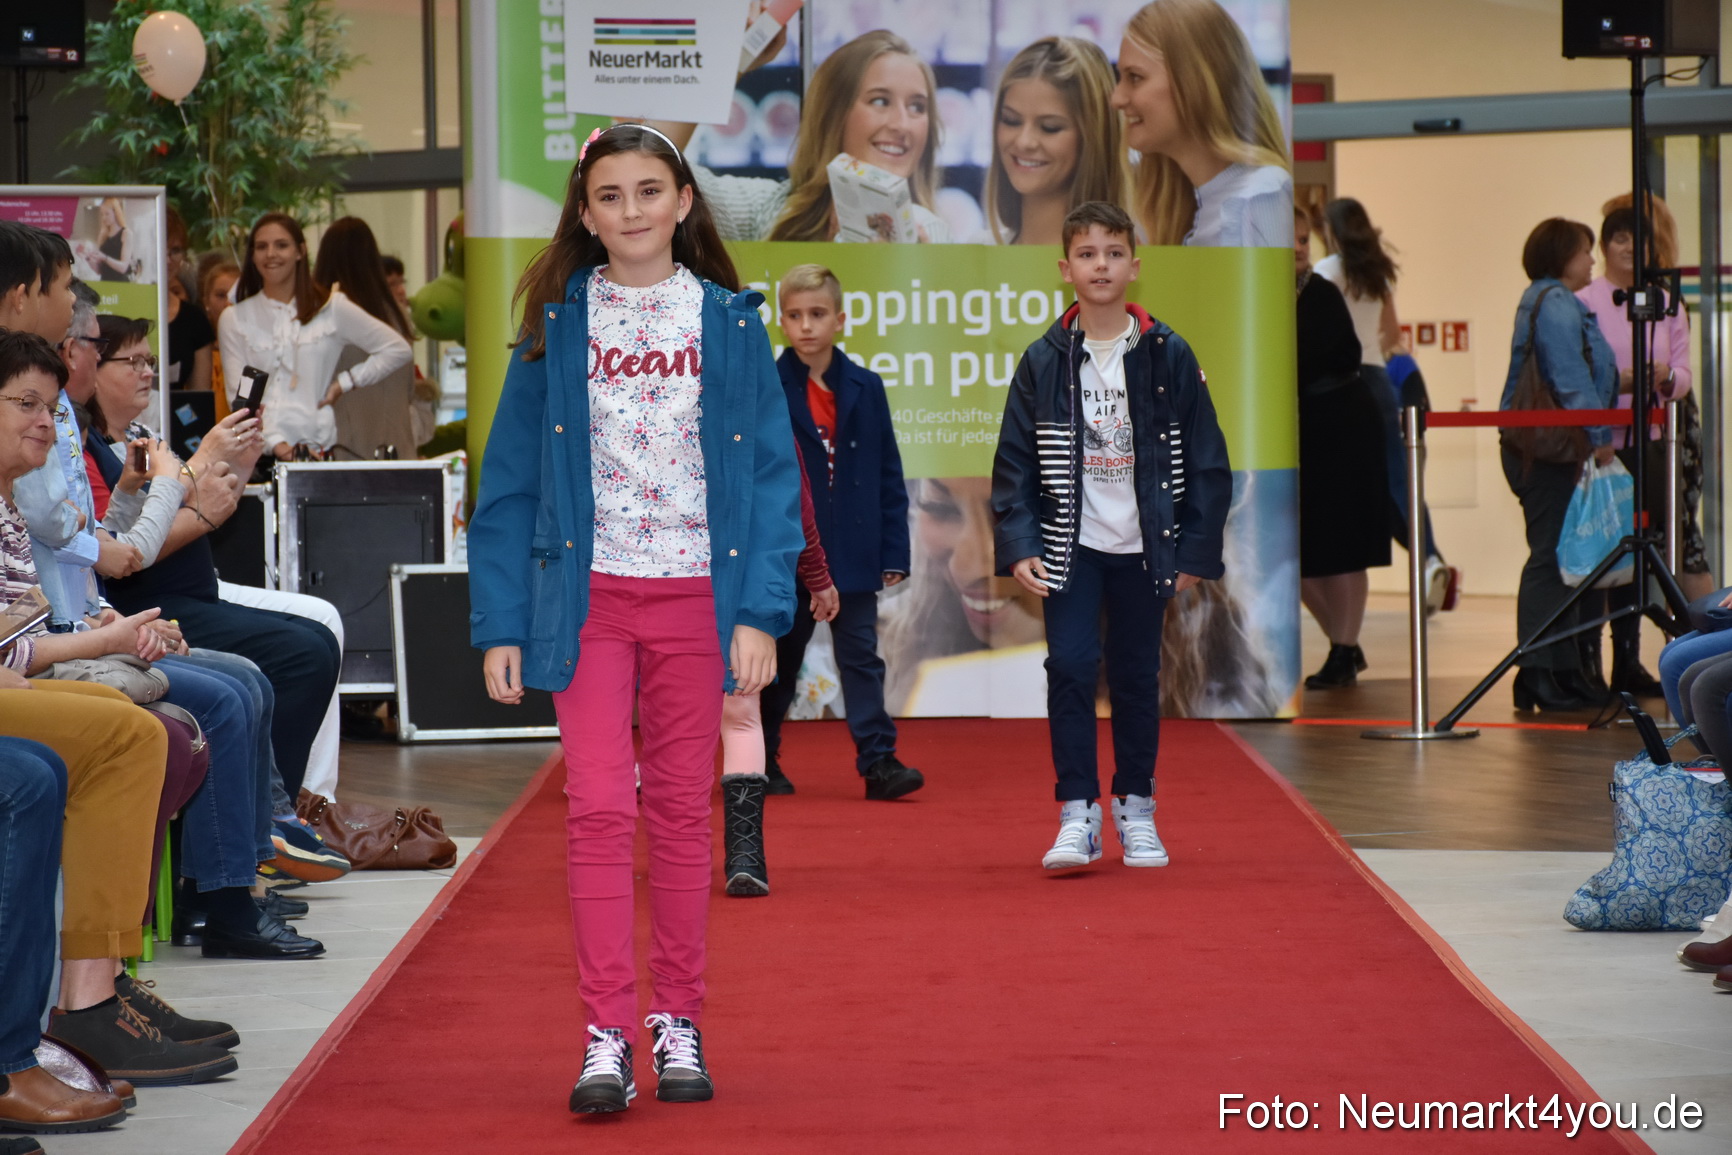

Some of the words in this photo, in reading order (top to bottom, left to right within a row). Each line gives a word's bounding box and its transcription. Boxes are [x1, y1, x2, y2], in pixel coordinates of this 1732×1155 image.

[589, 50, 702, 68] NeuerMarkt
[594, 75, 615, 84] Alles
[617, 75, 641, 84] unter
[643, 75, 672, 84] einem
[673, 74, 700, 84] Dach.
[950, 351, 1018, 397] pu
[1083, 389, 1125, 402] PLEIN
[916, 408, 993, 424] Geschäfte
[1095, 404, 1117, 417] AIR
[914, 430, 933, 444] ist
[936, 429, 959, 443] für
[1083, 456, 1103, 466] LES
